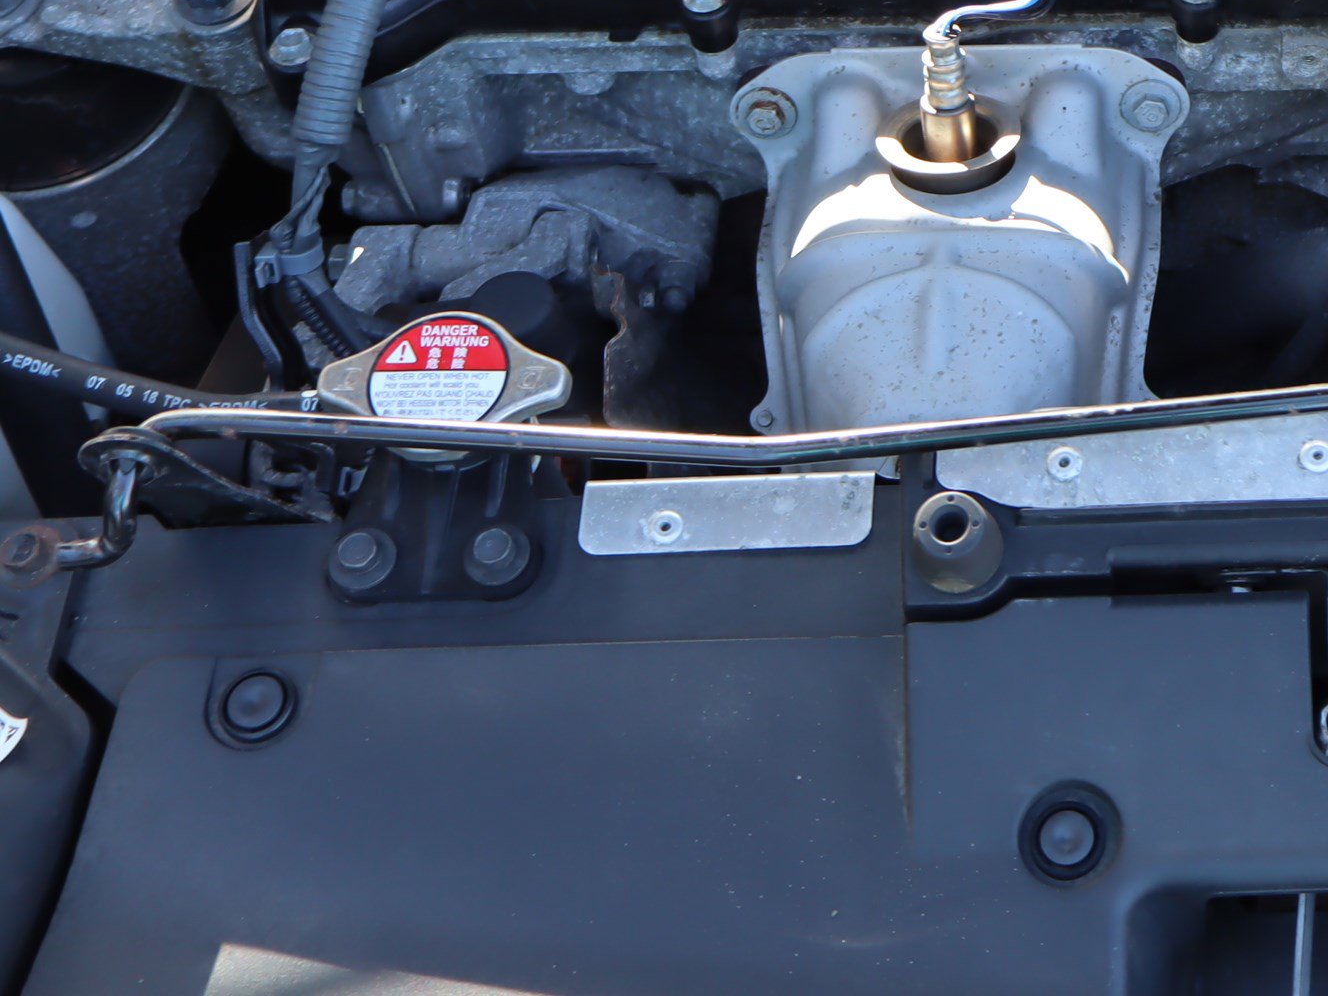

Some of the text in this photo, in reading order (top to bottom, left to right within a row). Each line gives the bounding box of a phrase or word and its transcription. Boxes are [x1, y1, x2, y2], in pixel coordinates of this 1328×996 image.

[421, 324, 479, 336] DANGER
[420, 335, 490, 347] WARNUNG
[386, 373, 415, 381] NEVER
[416, 373, 440, 381] OPEN
[86, 375, 107, 390] 07
[116, 383, 135, 398] 05
[142, 390, 159, 404] 18
[301, 398, 319, 411] 07
[416, 390, 432, 398] PAS
